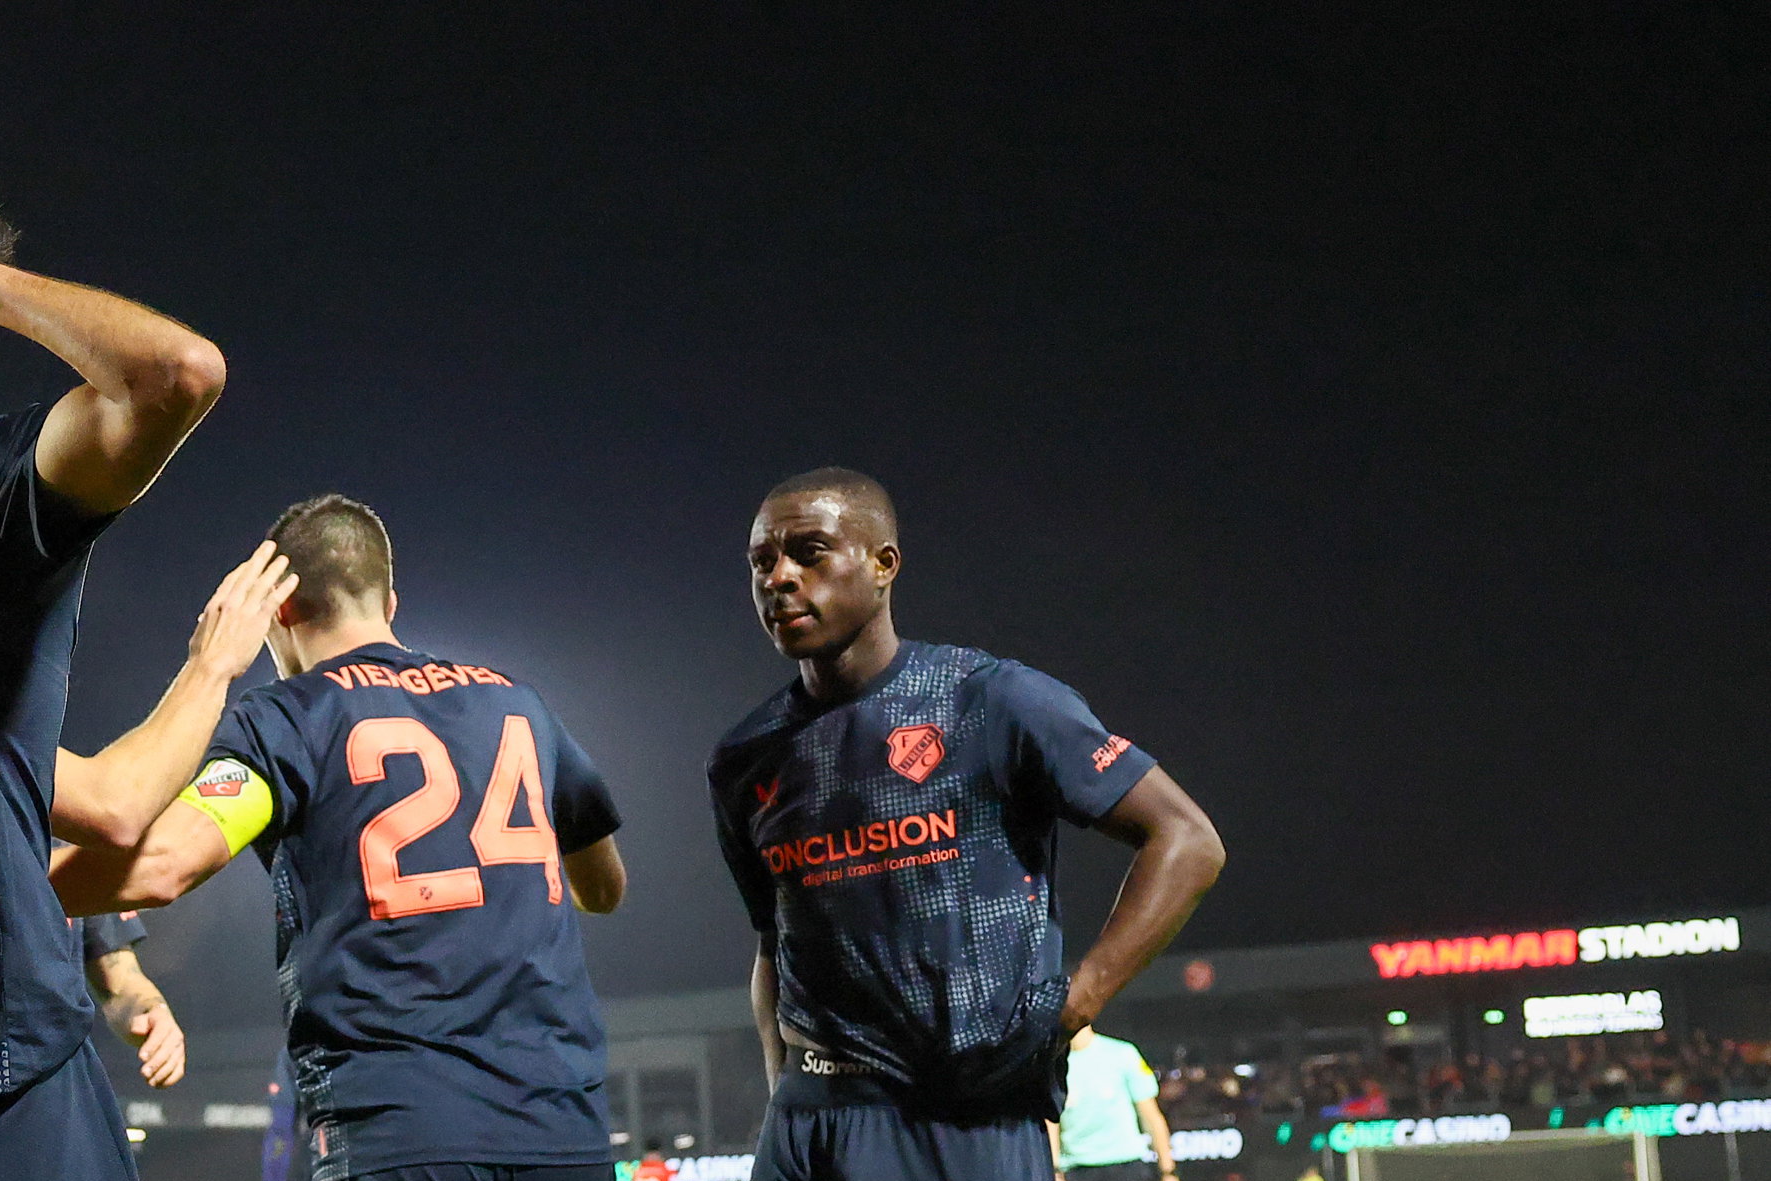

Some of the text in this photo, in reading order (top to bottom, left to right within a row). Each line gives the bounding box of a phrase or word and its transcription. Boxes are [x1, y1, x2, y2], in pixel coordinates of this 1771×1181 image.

[346, 715, 563, 920] 24
[802, 848, 959, 887] digital transformation
[1371, 917, 1741, 979] YANMAR STADION
